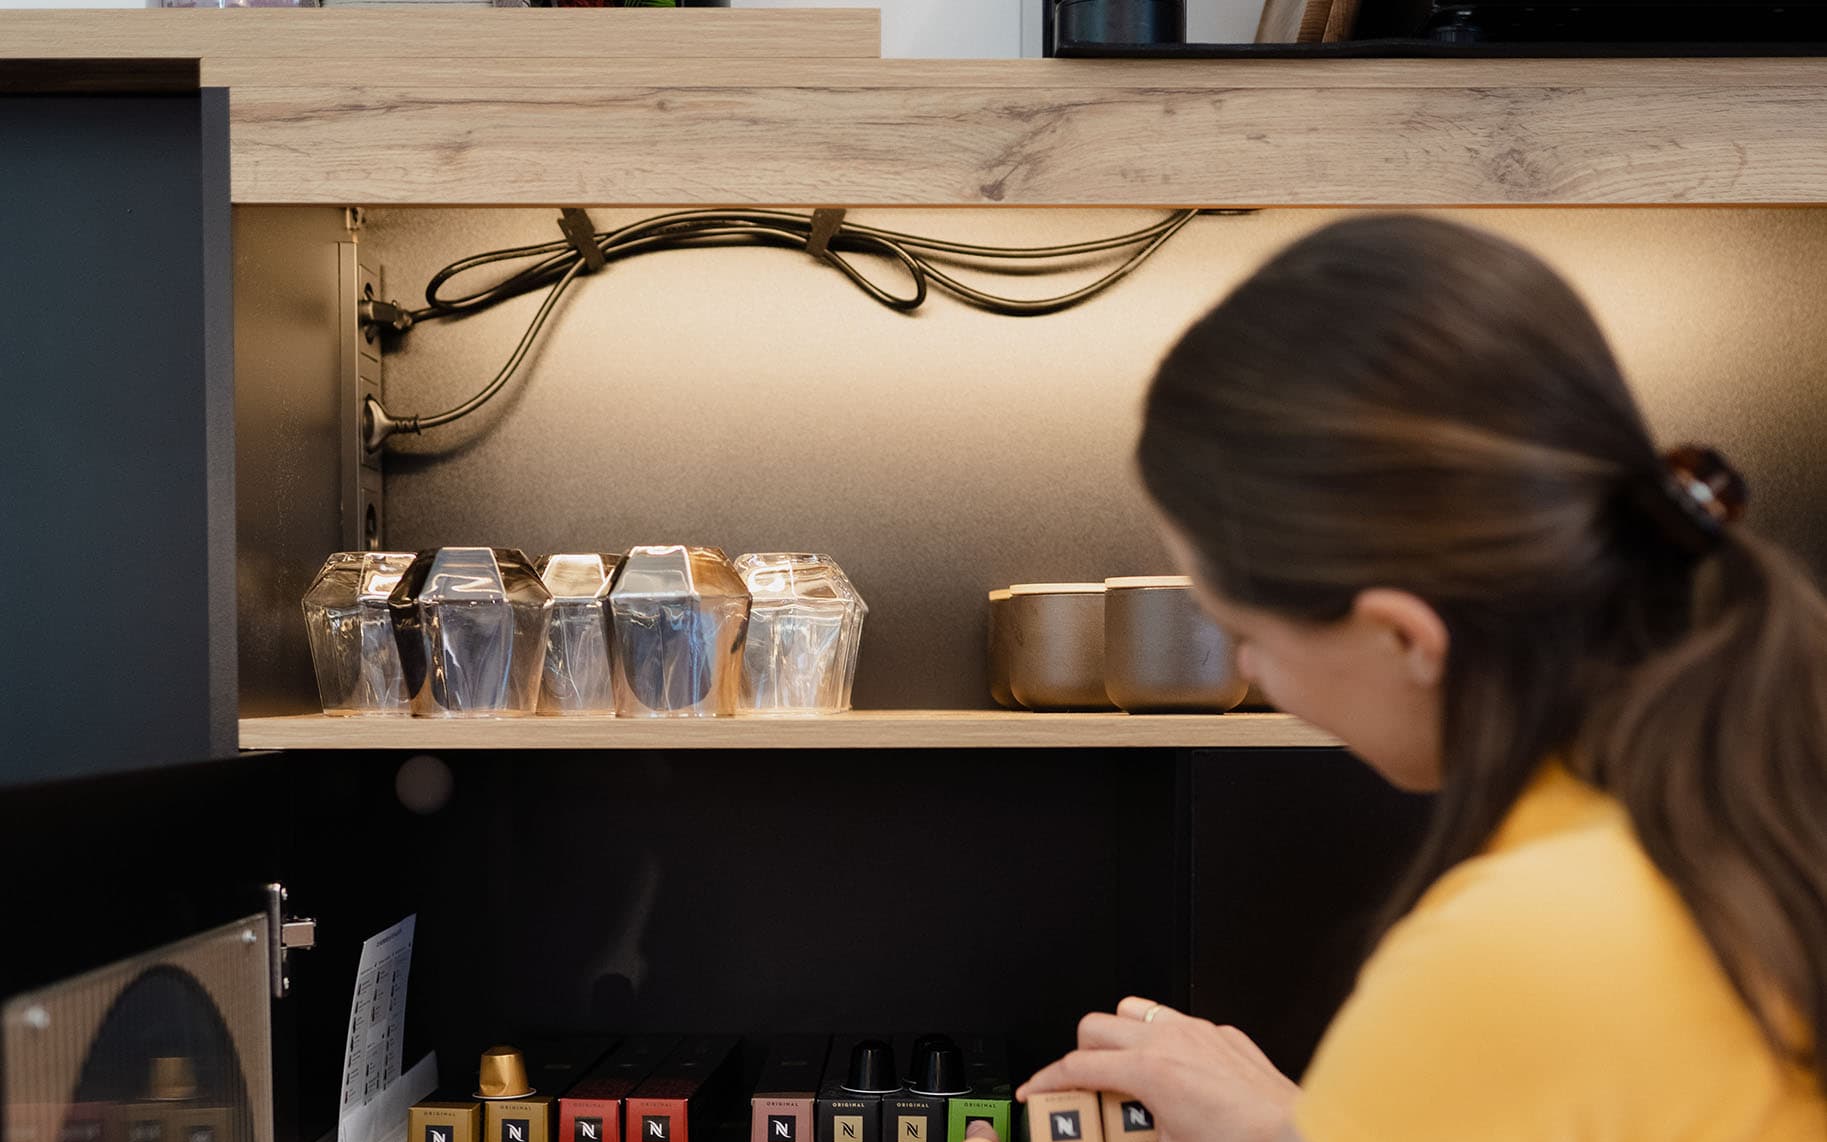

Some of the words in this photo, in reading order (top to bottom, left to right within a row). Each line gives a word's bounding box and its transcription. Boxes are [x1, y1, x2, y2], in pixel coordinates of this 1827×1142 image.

[1053, 1115, 1077, 1136] N
[1128, 1106, 1148, 1127] N
[506, 1123, 525, 1142] N
[580, 1121, 598, 1140] N
[648, 1120, 666, 1139] N
[773, 1120, 791, 1138] N
[841, 1121, 856, 1139] N
[905, 1121, 920, 1139] N
